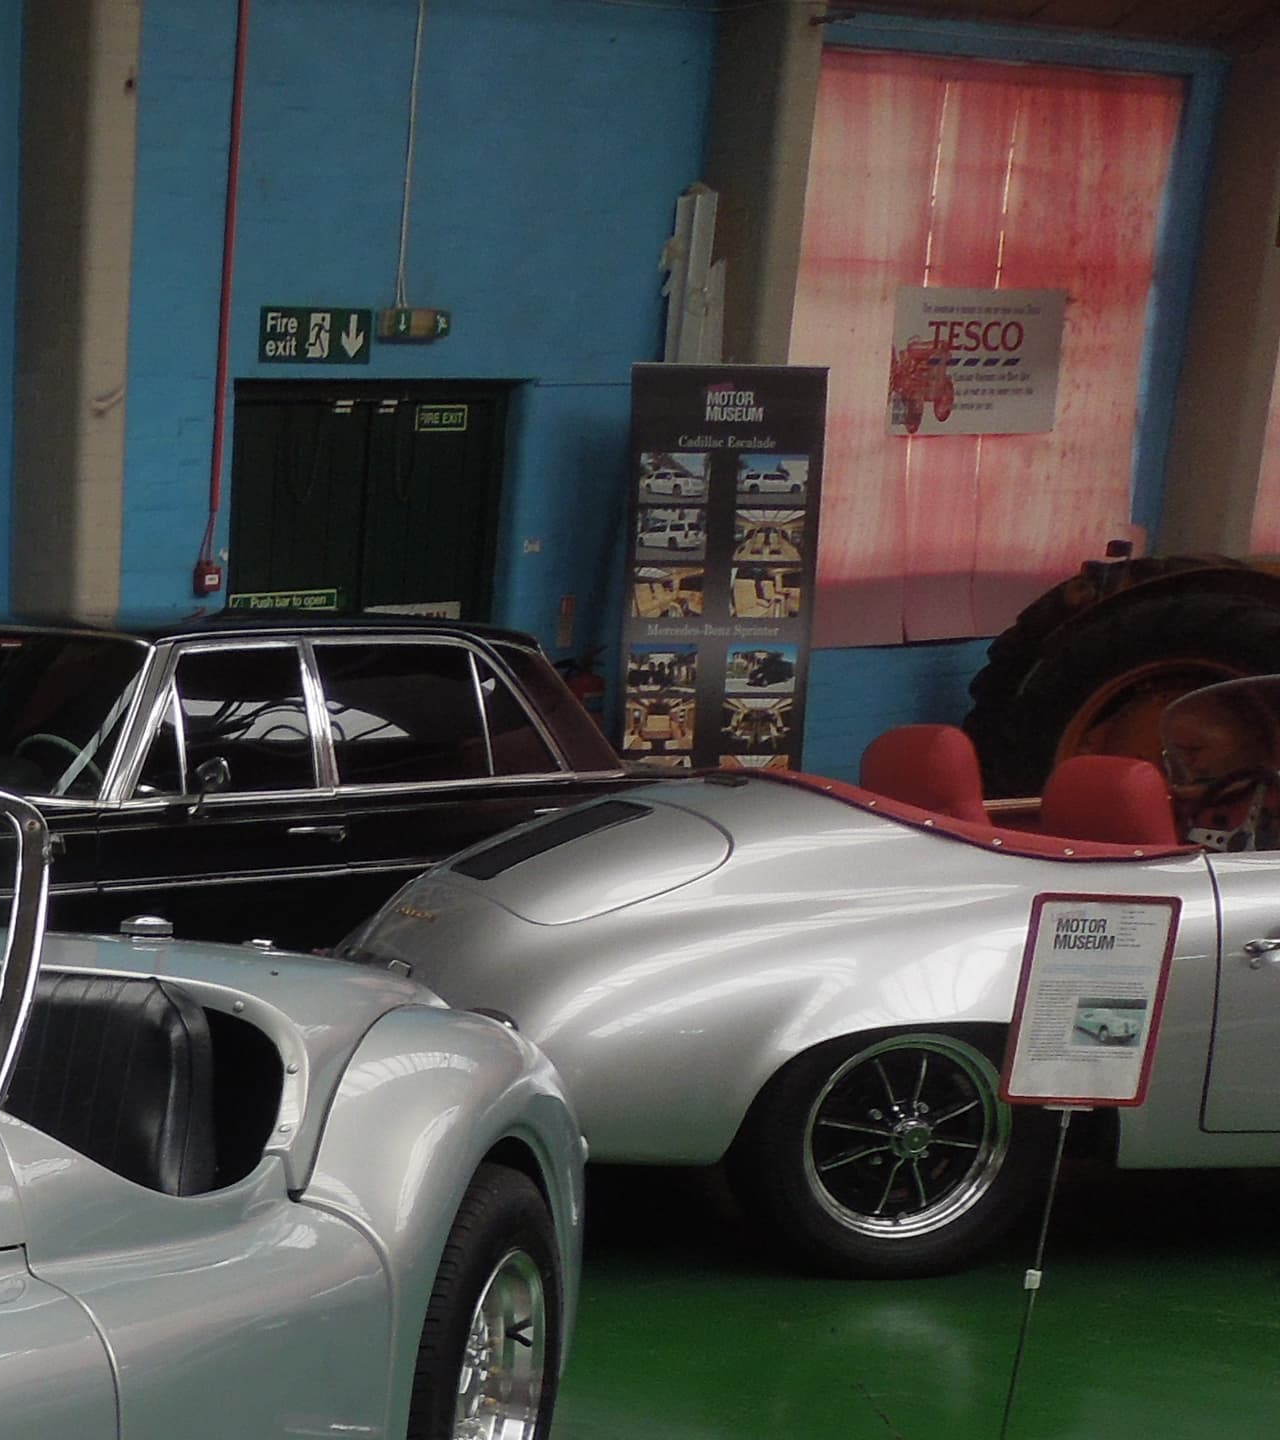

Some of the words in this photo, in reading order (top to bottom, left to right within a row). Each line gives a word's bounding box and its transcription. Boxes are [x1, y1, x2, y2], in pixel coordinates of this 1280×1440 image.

[266, 312, 298, 333] Fire
[927, 320, 1024, 352] TESCO
[265, 337, 298, 356] exit
[707, 391, 754, 405] MOTOR
[420, 412, 440, 425] FIRE
[442, 411, 465, 424] EXIT
[705, 407, 764, 422] MUSEUM
[678, 435, 724, 448] Cadillac
[727, 436, 777, 448] Escalade
[250, 597, 273, 608] Push
[276, 596, 290, 607] bar
[292, 596, 302, 606] to
[304, 596, 327, 608] open
[1056, 918, 1107, 933] MOTOR
[1053, 934, 1116, 950] MUSEUM
